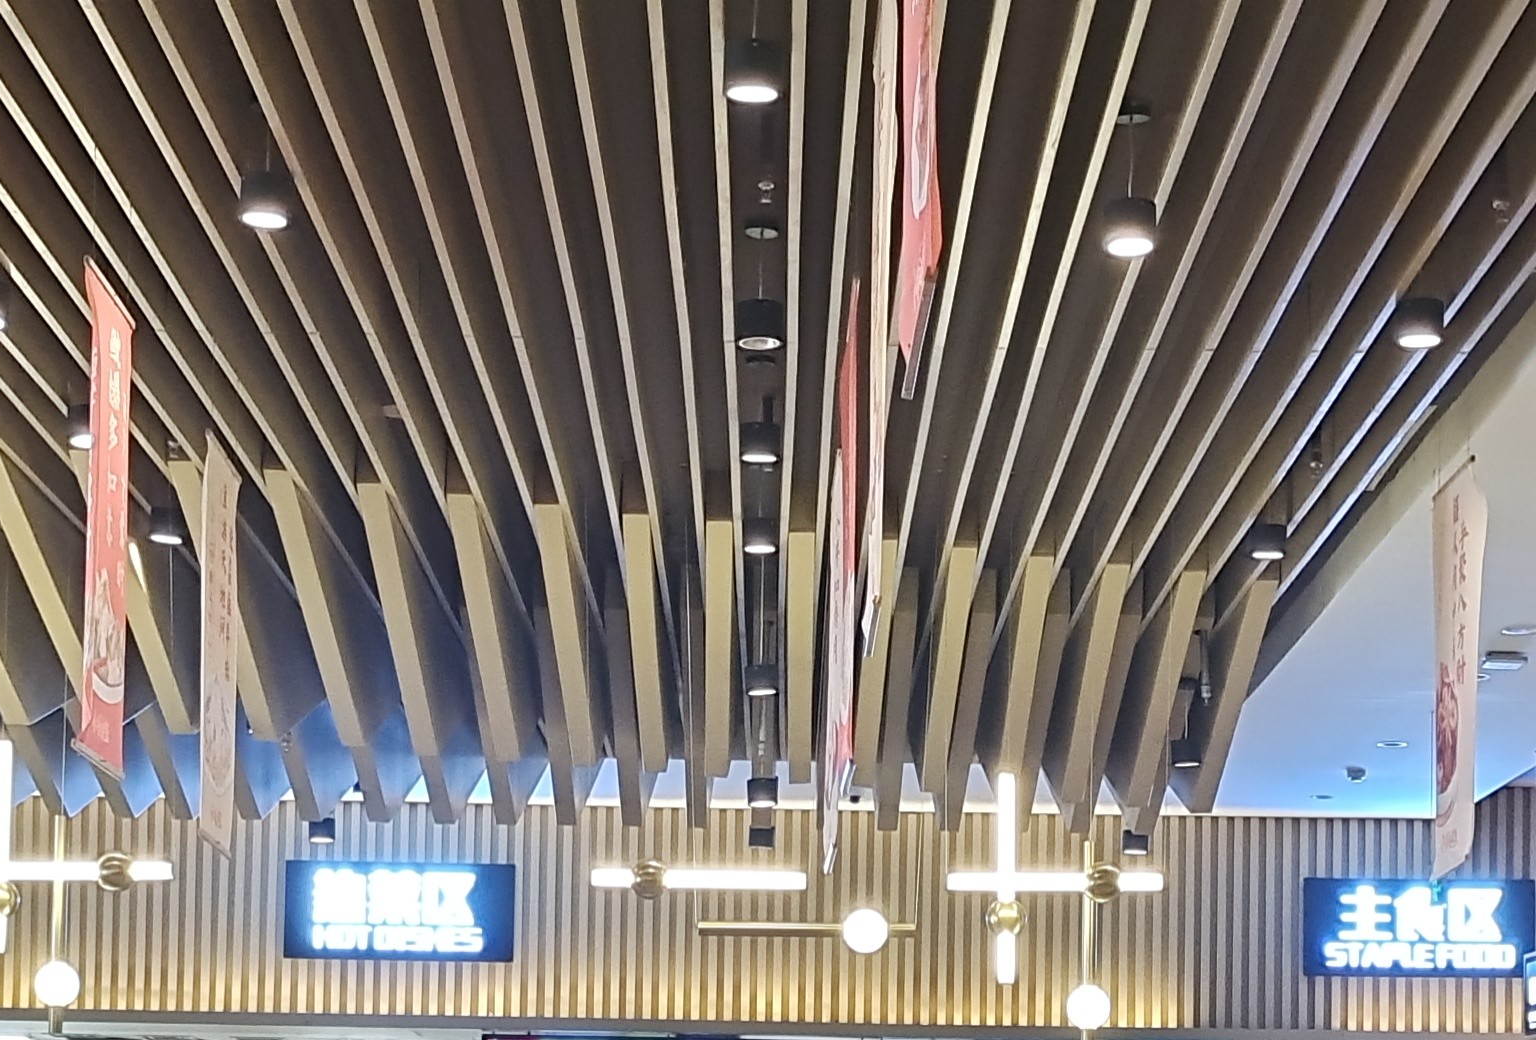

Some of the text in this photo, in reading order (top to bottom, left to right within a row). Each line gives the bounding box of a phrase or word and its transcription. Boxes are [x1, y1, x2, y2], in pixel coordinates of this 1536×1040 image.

[1337, 884, 1504, 942] 主食区
[312, 923, 373, 950] HOT
[1324, 941, 1516, 969] STAPLE FOOD
